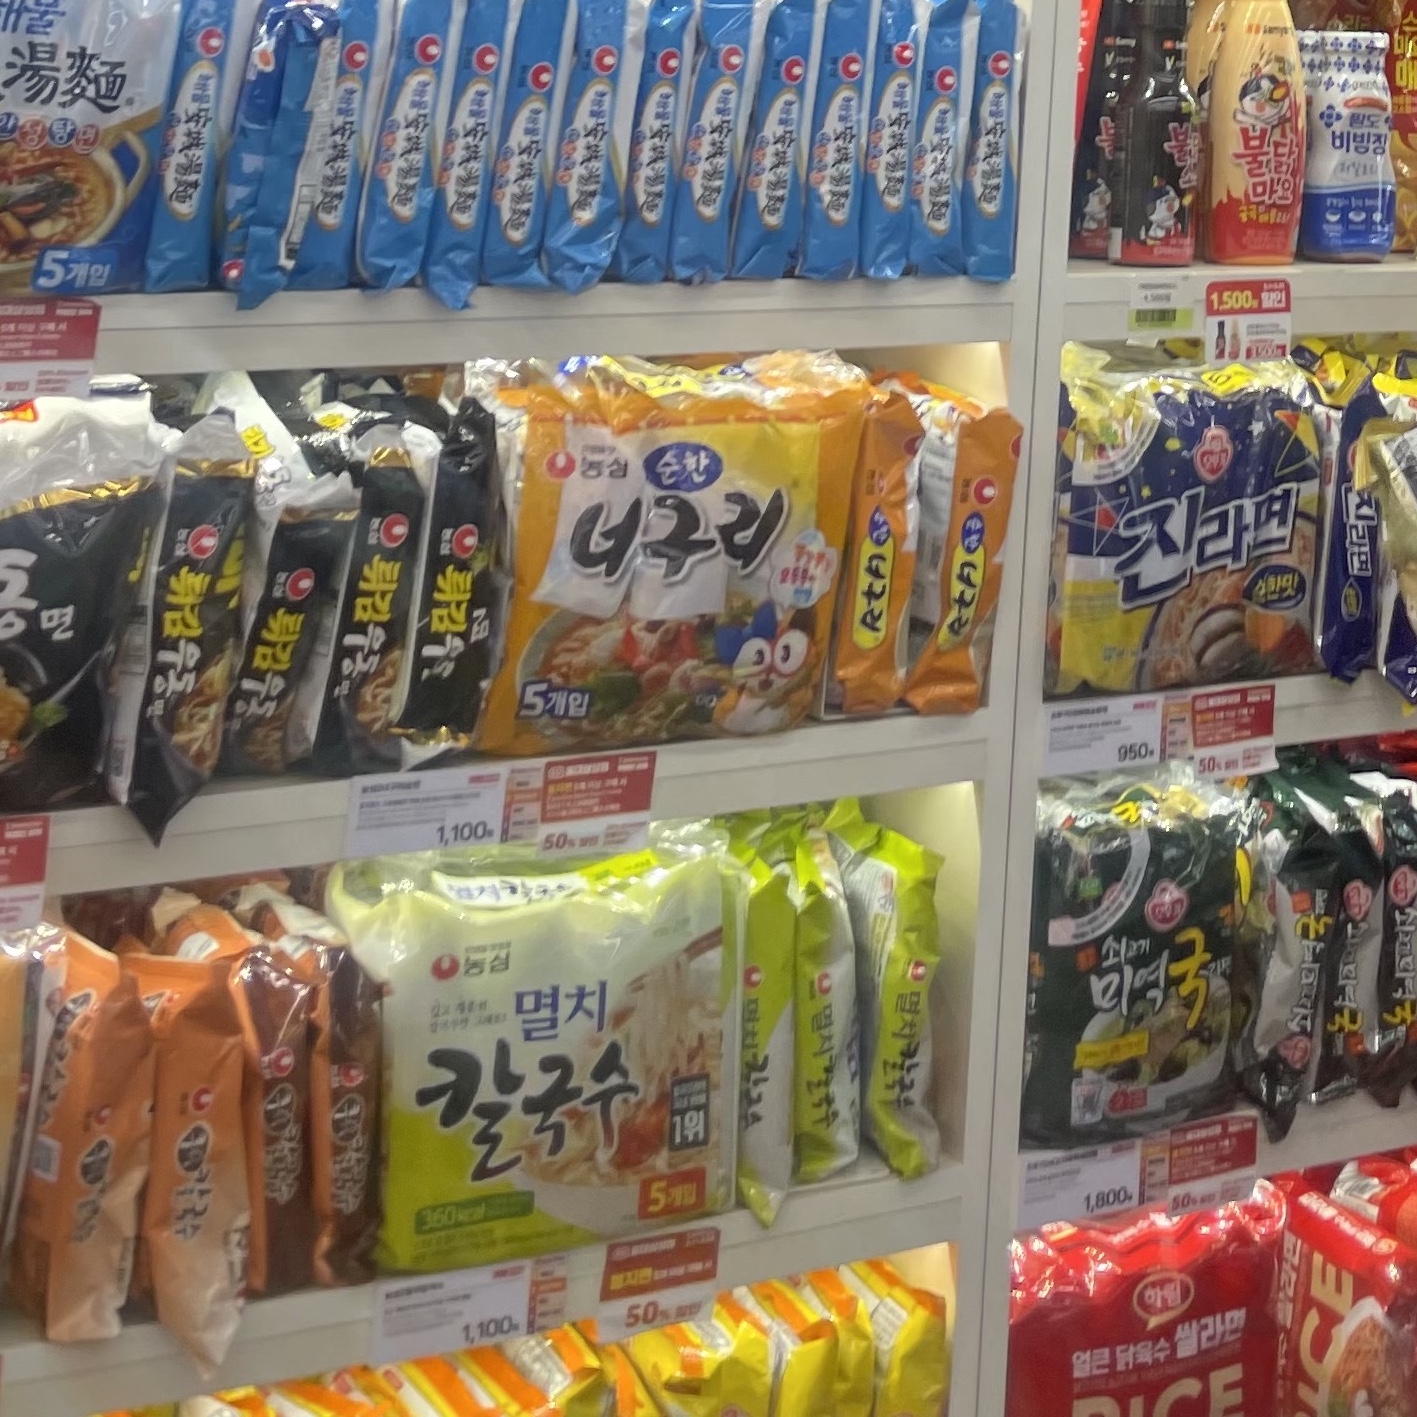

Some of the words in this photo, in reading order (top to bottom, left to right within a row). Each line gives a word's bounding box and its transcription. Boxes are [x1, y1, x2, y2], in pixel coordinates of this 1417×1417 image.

[1231, 125, 1298, 179] 불닭
[1248, 176, 1295, 206] 마요
[36, 251, 111, 289] 5개입
[655, 450, 711, 484] 순한
[569, 486, 789, 579] 너구리
[1115, 482, 1299, 612] 진라면
[162, 565, 211, 639] 튀김
[354, 553, 402, 625] 튀김
[430, 563, 474, 636] 튀김
[253, 606, 306, 672] 튀김
[518, 685, 590, 718] 5개입
[1117, 742, 1155, 763] 950
[1089, 926, 1214, 1031] 미역국
[515, 979, 608, 1043] 멸치
[415, 1037, 641, 1184] 칼국수
[672, 1108, 706, 1147] 1위
[647, 1179, 698, 1215] 5개입
[1083, 1185, 1133, 1215] 1,800
[1143, 1283, 1184, 1313] 하림
[462, 1314, 520, 1346] 1,100
[1071, 1348, 1110, 1381] 얼큰
[1114, 1338, 1171, 1372] 닭육수
[1174, 1305, 1247, 1357] 쌀라면
